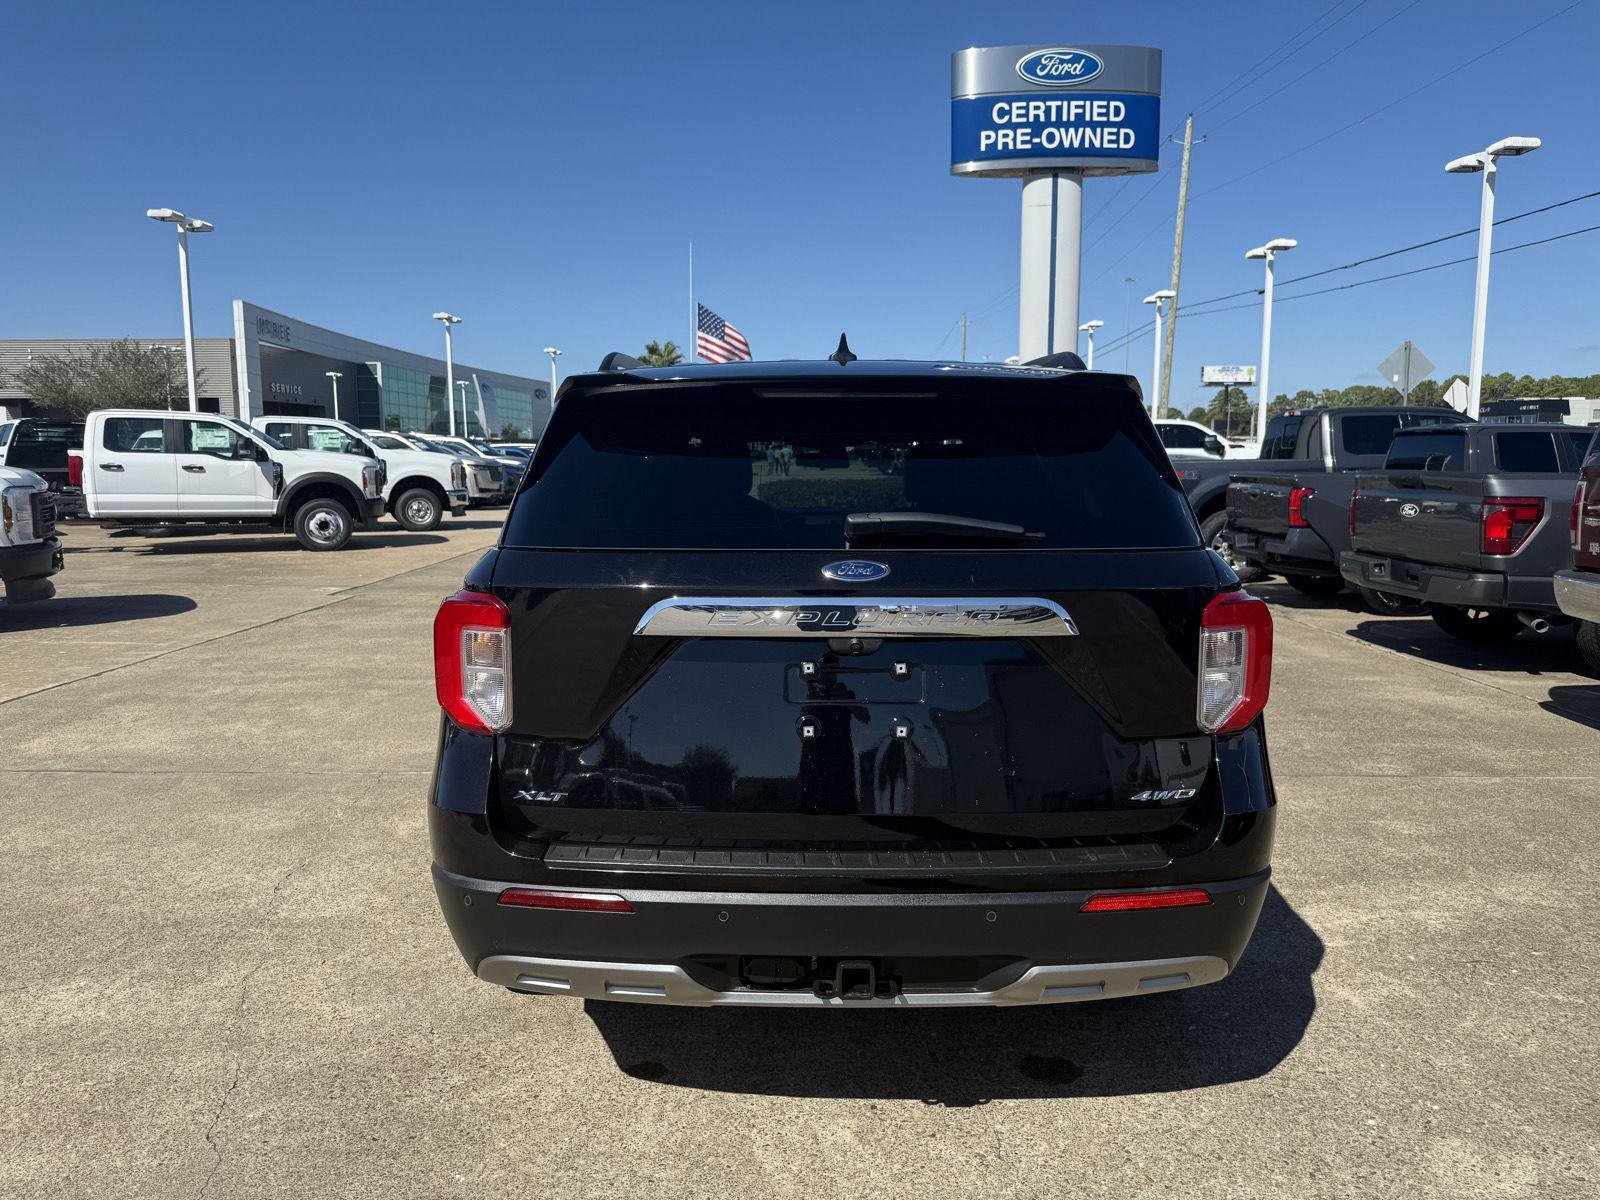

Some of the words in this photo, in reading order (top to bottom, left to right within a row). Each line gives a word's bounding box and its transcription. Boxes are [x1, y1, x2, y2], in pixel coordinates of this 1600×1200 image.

[1036, 54, 1085, 76] Ford
[992, 101, 1126, 124] CERTIFIED
[980, 127, 1135, 151] PRE-OWNED
[271, 382, 302, 395] SERVICE
[837, 562, 874, 575] Ford
[706, 610, 1001, 627] EXPLORER
[513, 790, 569, 801] XLT
[1130, 788, 1196, 801] 4WD
